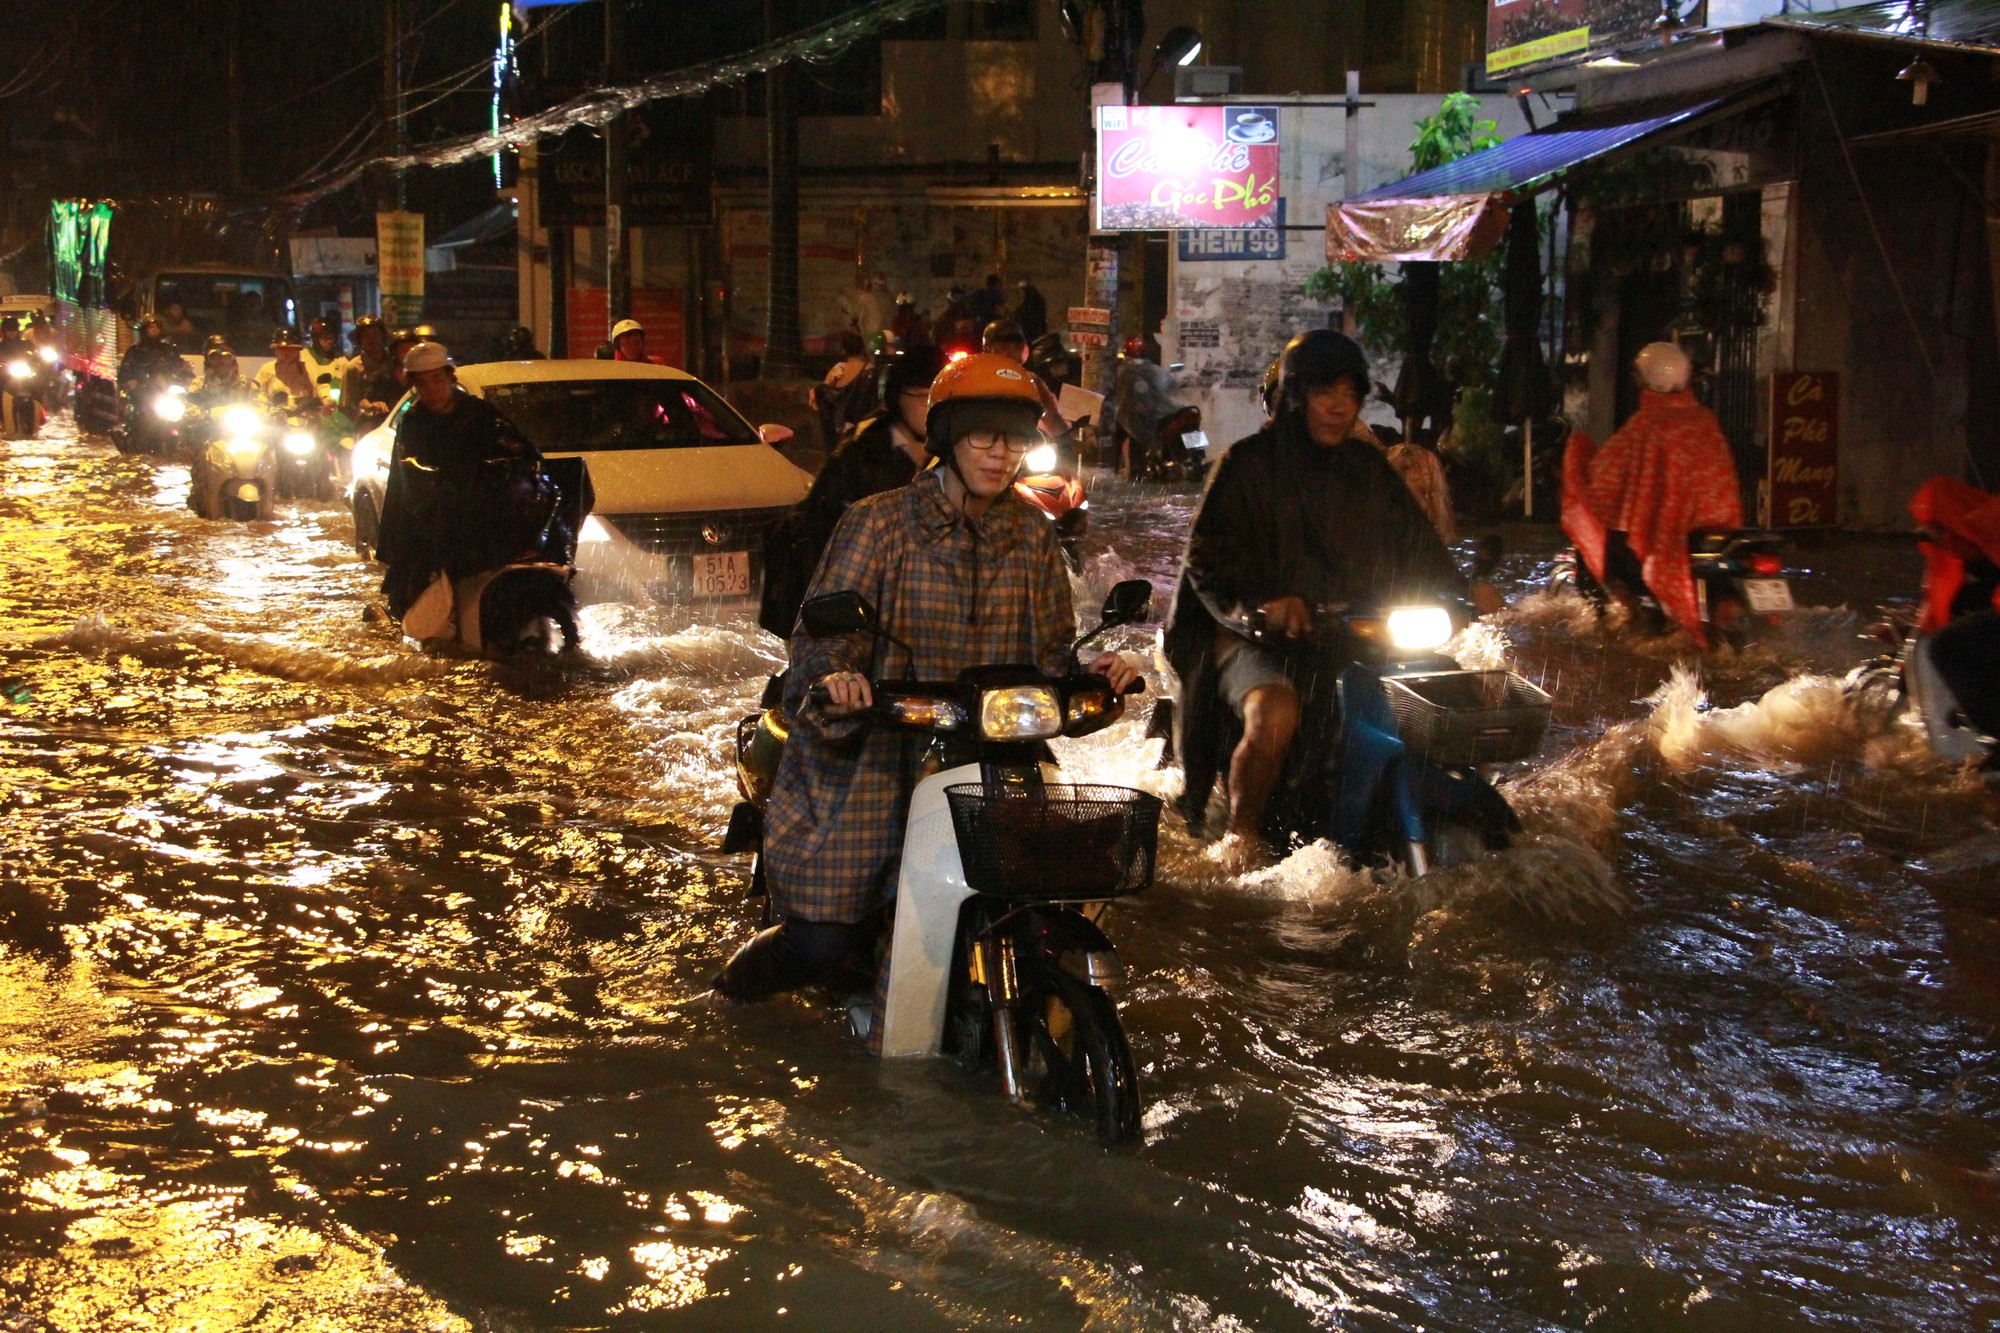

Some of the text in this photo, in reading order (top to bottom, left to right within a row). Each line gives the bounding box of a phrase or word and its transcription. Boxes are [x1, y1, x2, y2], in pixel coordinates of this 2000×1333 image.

[1150, 173, 1276, 211] Góc Phố
[1248, 230, 1279, 253] 98
[1787, 374, 1824, 406] Cà
[1783, 416, 1828, 444] Phê
[1775, 456, 1836, 489] Mang
[707, 556, 735, 575] 51A
